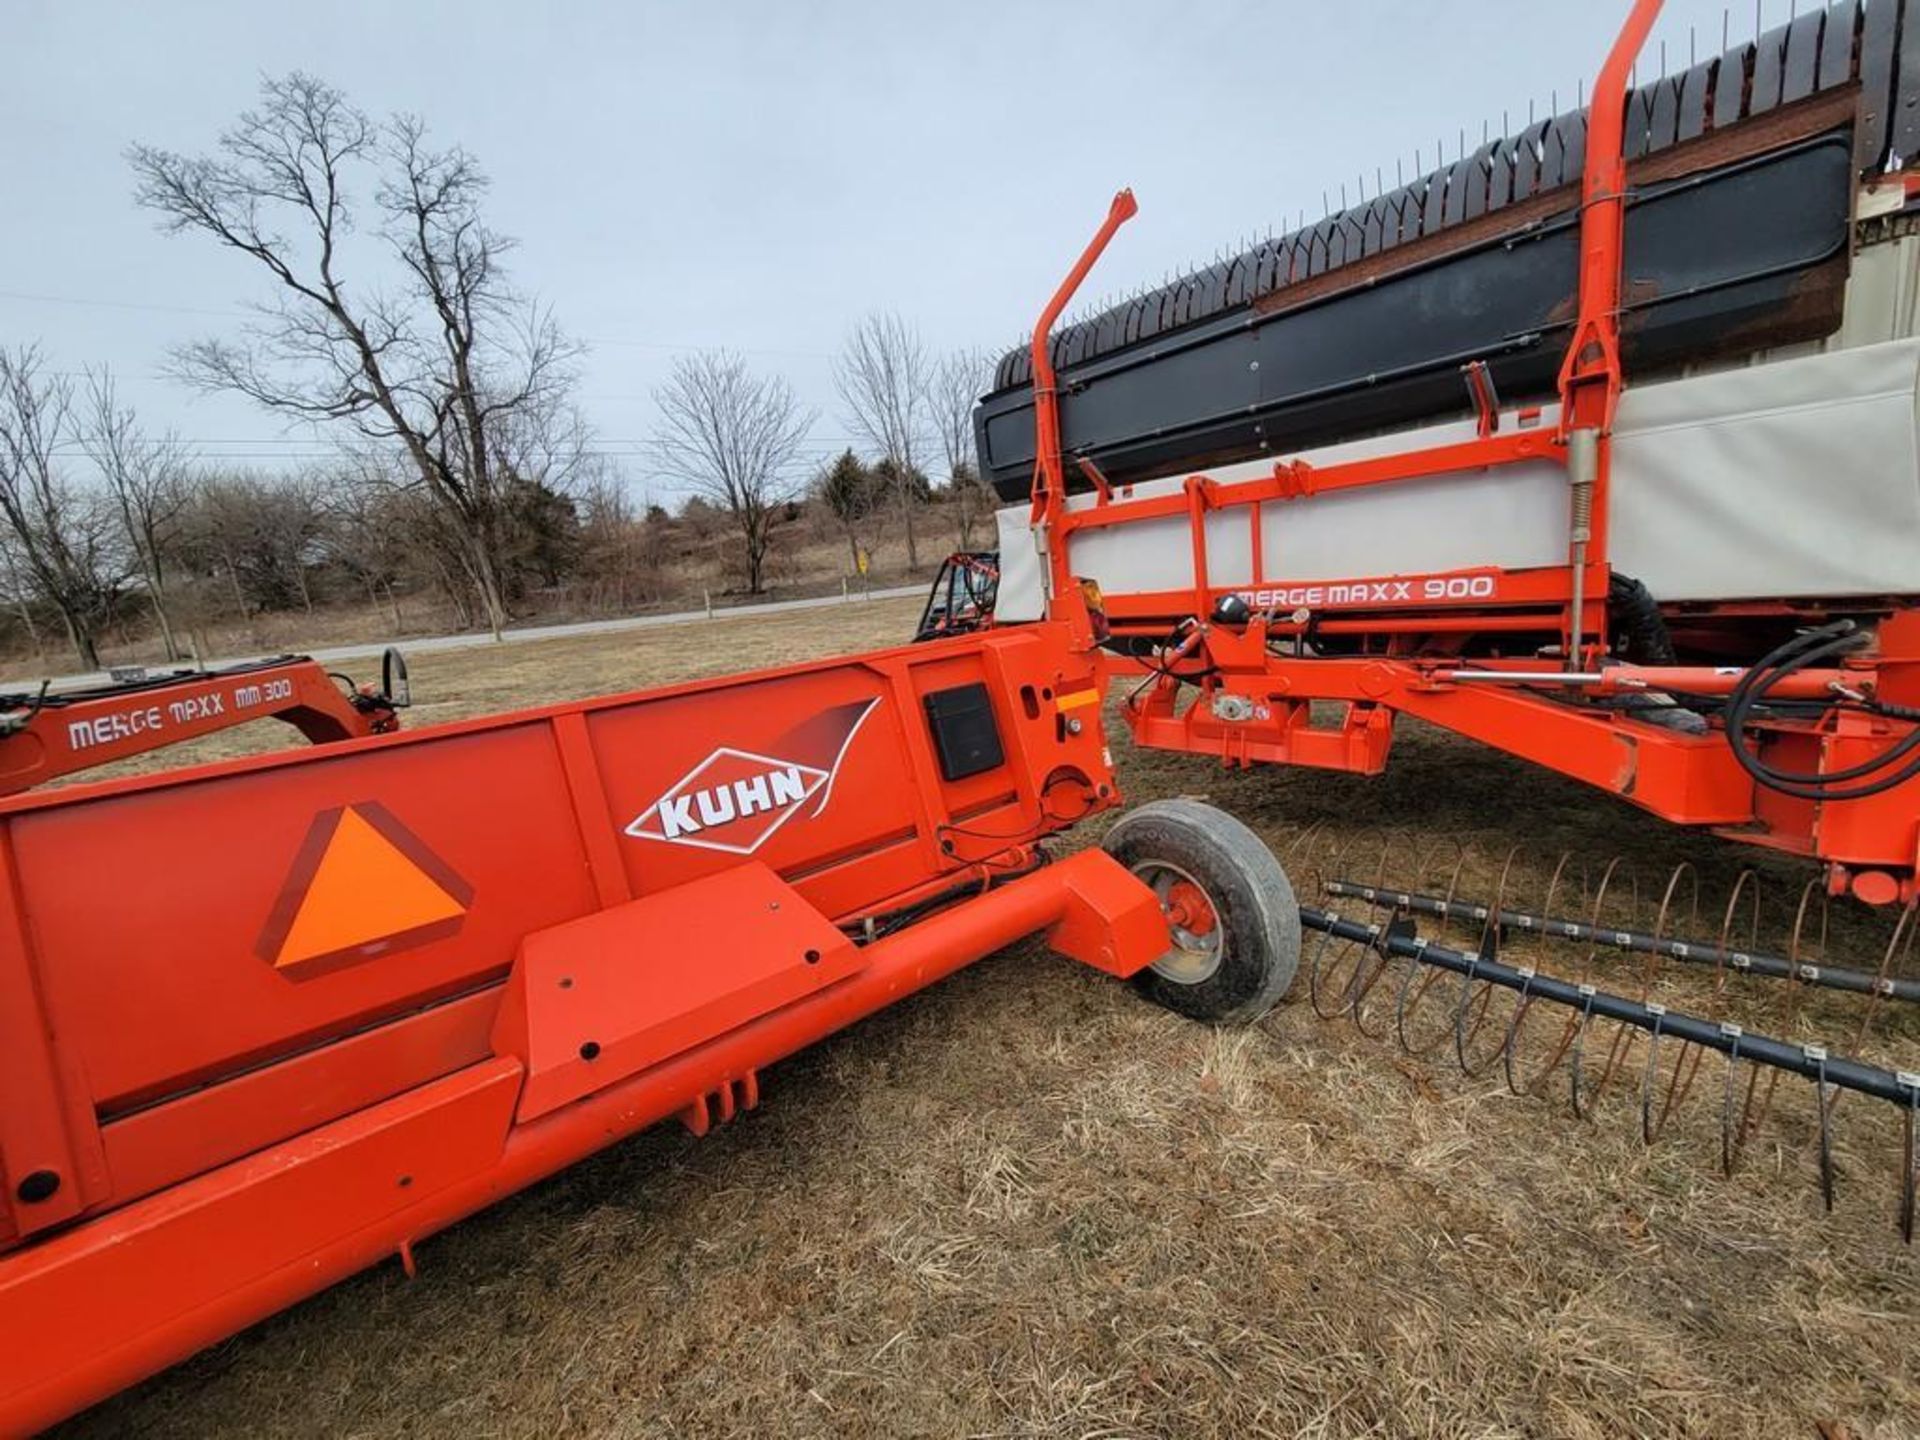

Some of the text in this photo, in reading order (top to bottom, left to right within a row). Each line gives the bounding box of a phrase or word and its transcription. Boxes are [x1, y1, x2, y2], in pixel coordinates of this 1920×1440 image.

[1236, 576, 1494, 606] MERGE MAXX 900
[265, 678, 292, 701] 300
[658, 766, 806, 839] KUHN
